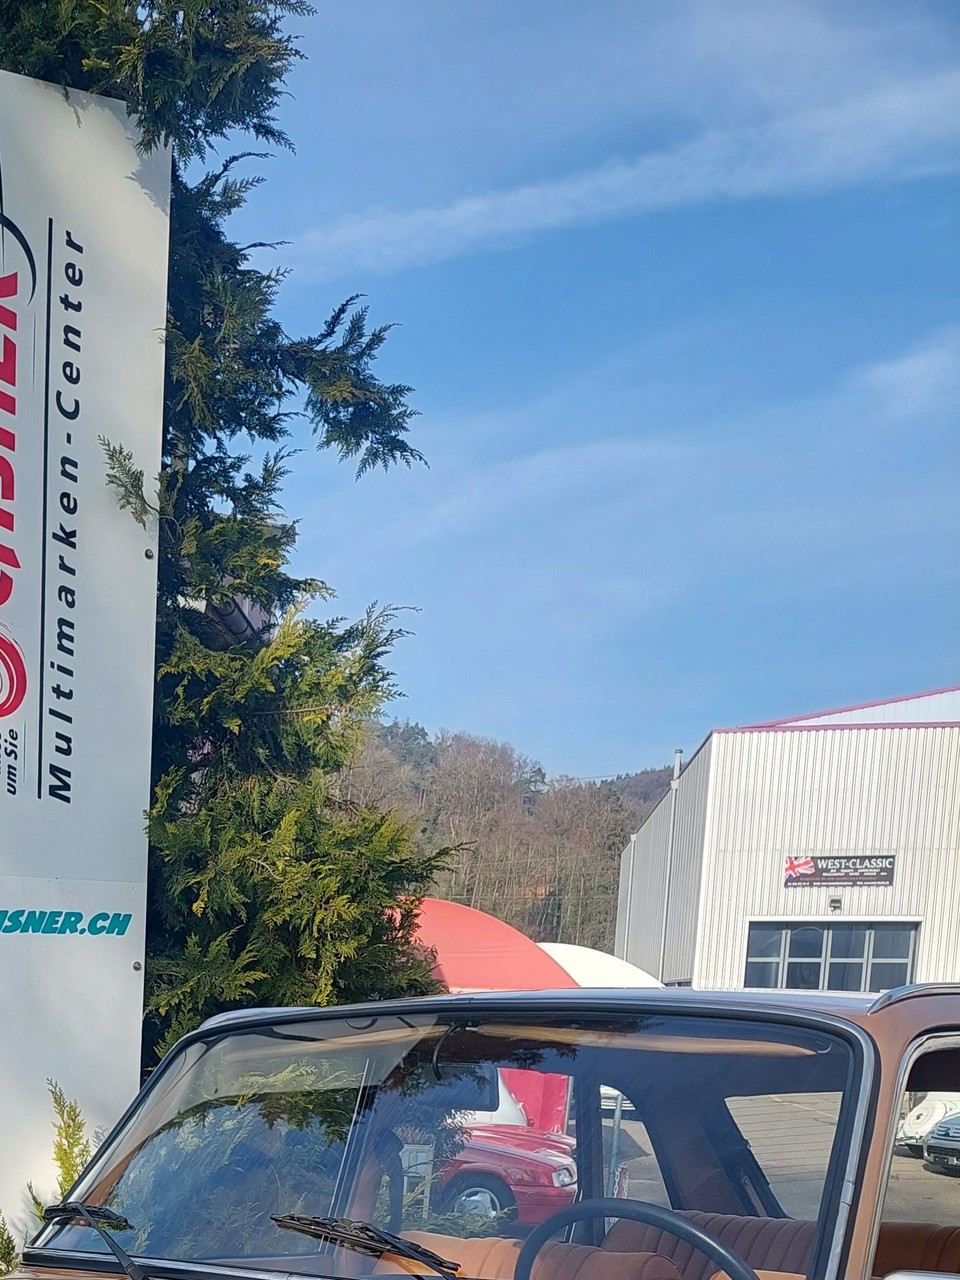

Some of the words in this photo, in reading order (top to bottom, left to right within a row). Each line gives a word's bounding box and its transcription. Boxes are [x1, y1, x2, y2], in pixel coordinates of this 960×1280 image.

[48, 231, 85, 804] Multimarken-Center
[4, 728, 18, 761] Sie
[7, 764, 17, 796] um
[817, 858, 894, 869] WEST-CLASSIC
